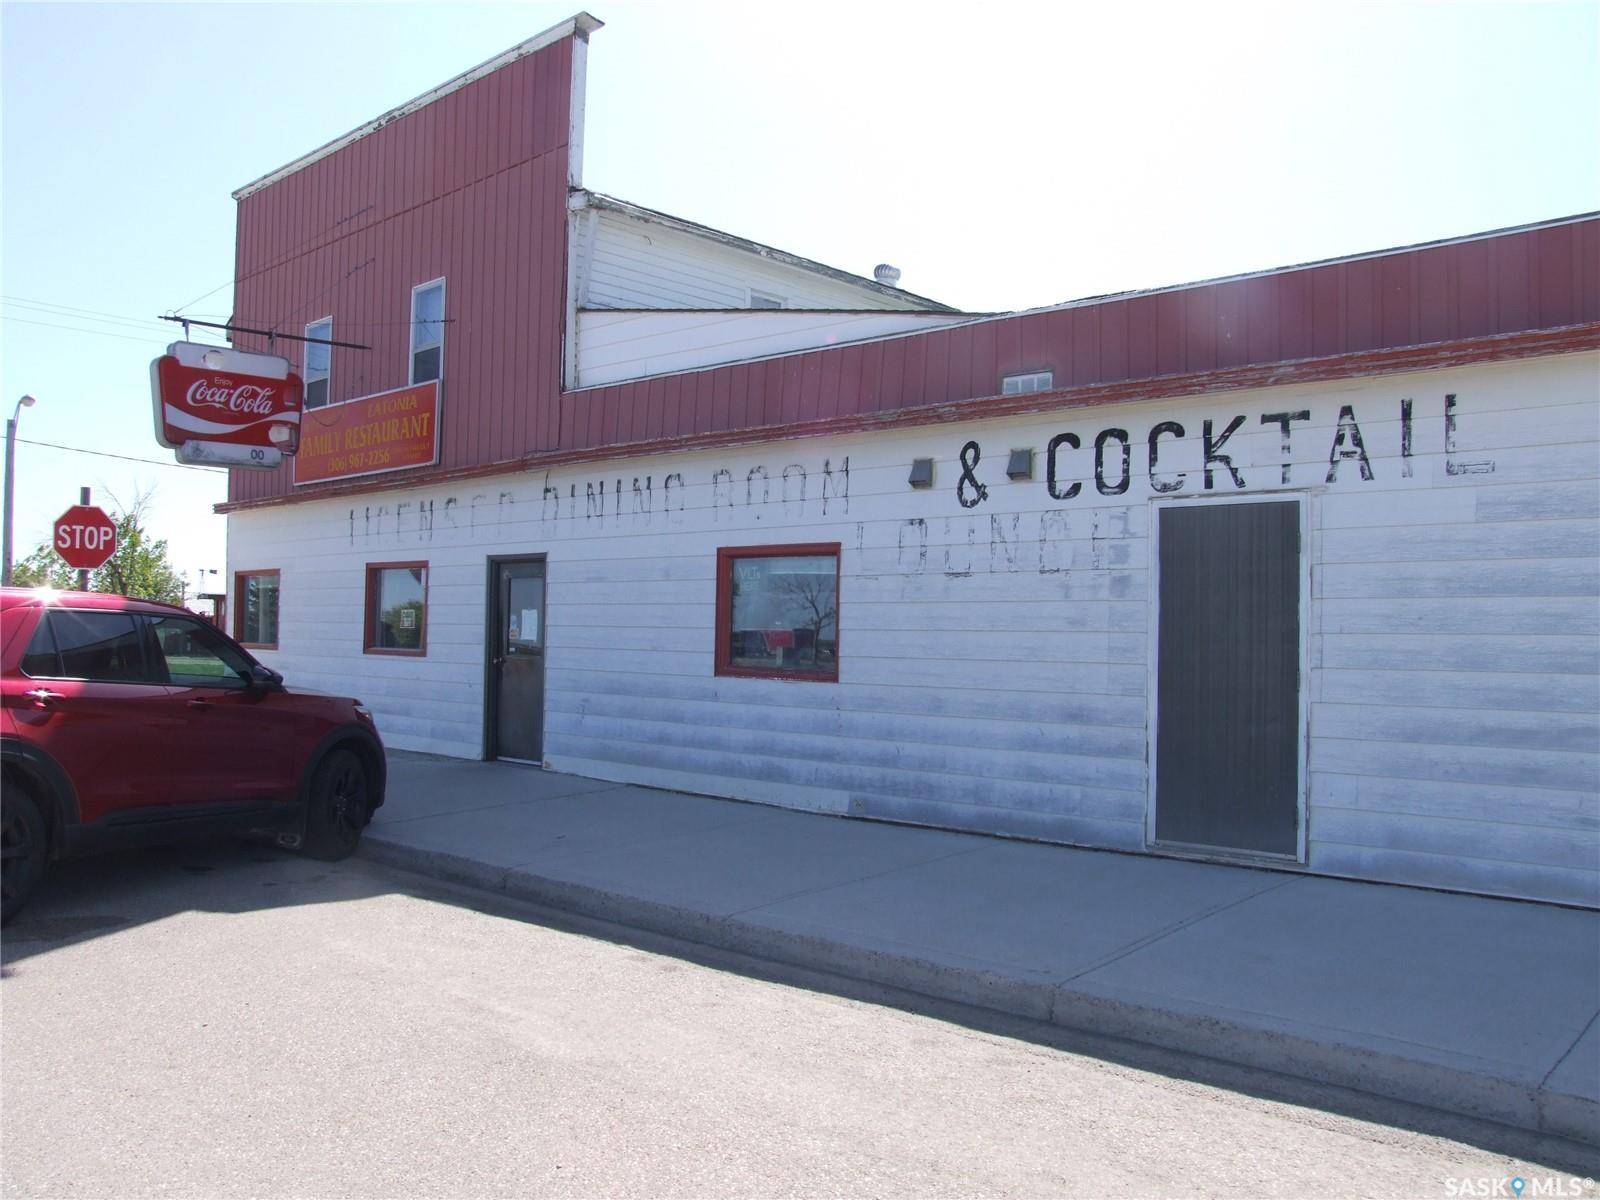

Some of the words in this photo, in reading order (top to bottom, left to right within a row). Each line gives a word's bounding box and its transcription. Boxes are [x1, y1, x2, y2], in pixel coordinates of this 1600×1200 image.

[214, 376, 233, 387] Enjoy
[367, 394, 418, 418] EATONIA
[300, 431, 341, 459] FAMILY
[344, 411, 431, 450] RESTAURANT
[348, 448, 391, 470] 967-2256
[957, 440, 988, 509] &
[1047, 393, 1496, 501] COCKTAIL
[57, 524, 113, 550] STOP
